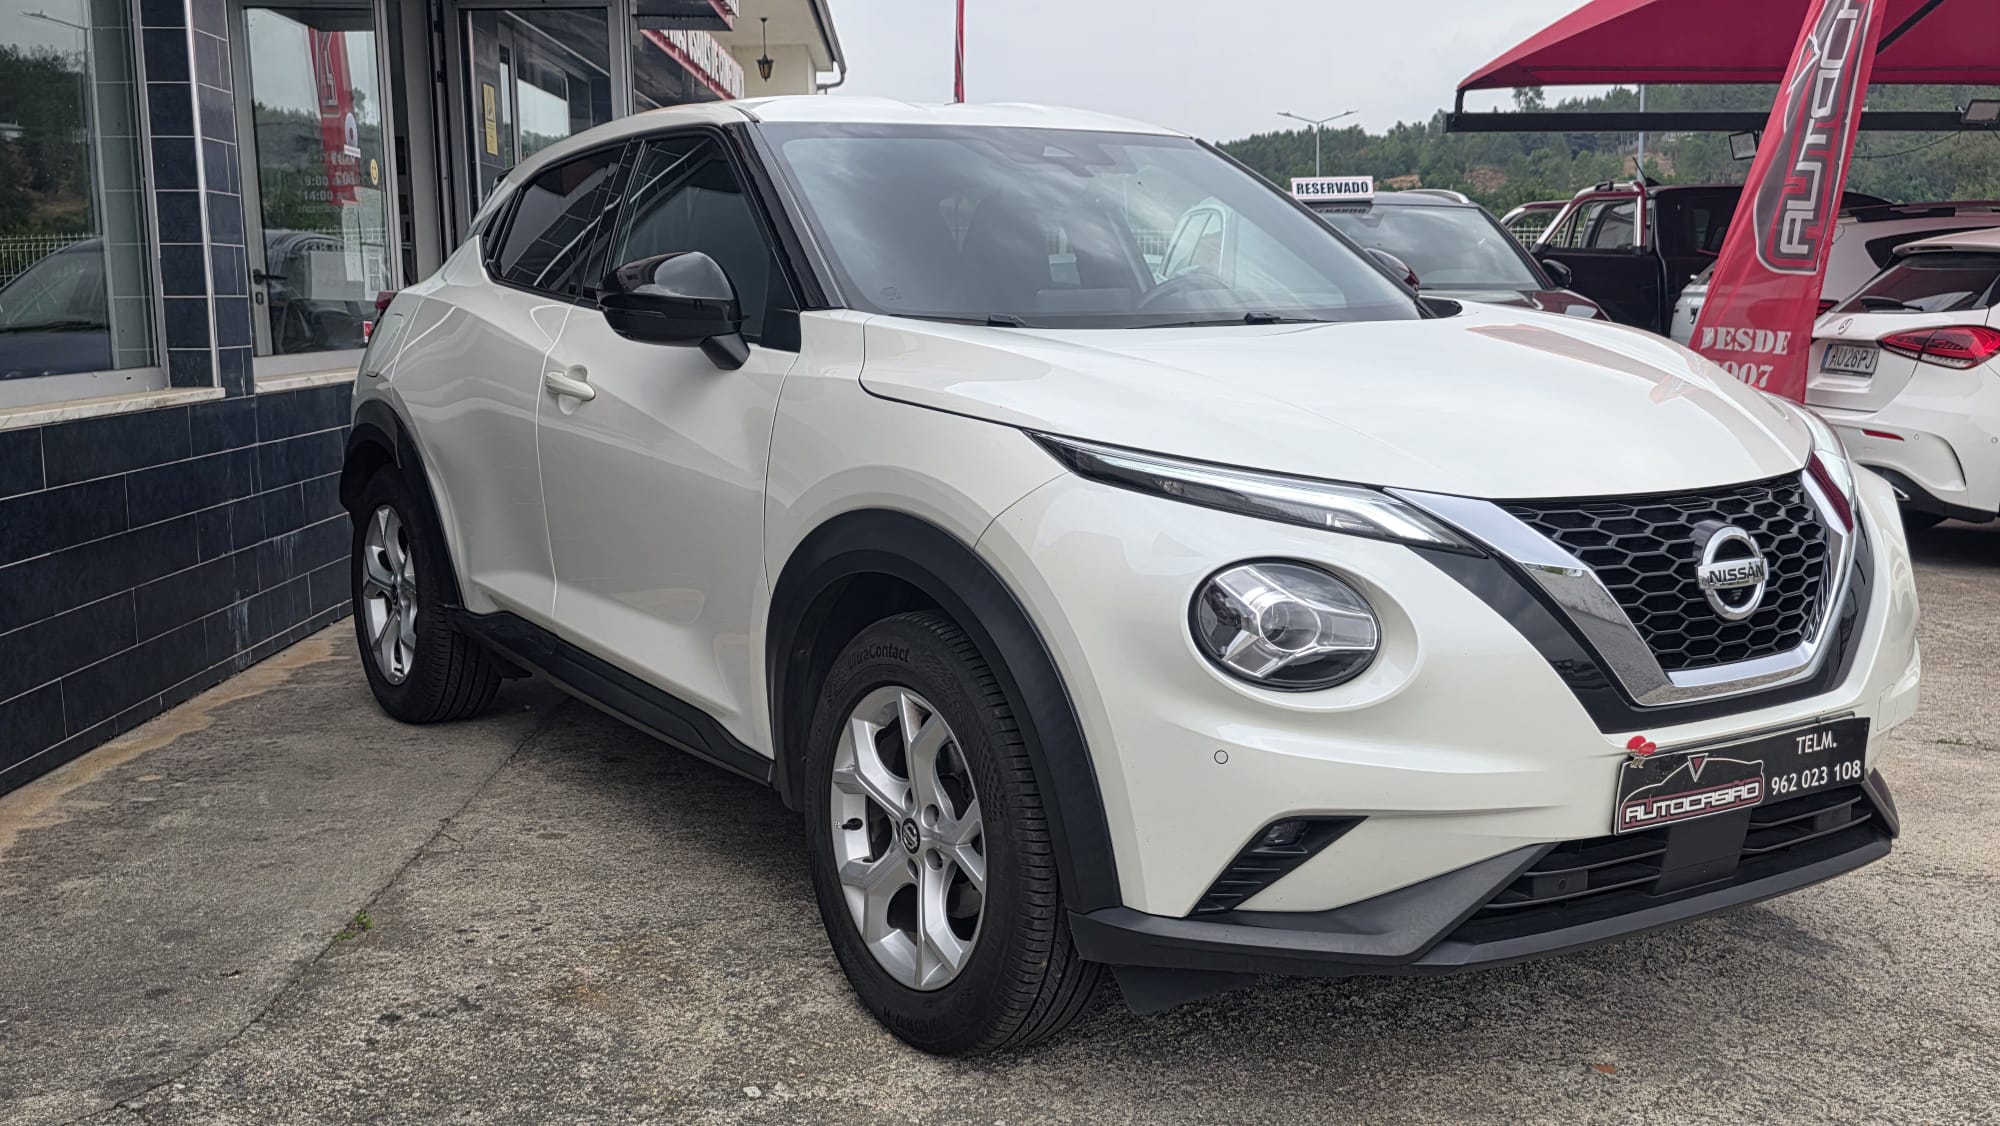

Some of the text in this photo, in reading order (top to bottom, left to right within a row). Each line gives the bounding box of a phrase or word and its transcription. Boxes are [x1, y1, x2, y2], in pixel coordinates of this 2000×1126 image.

[1295, 181, 1370, 195] RESERVADO
[1700, 327, 1792, 356] DESDE
[1711, 359, 1774, 389] 007
[1708, 561, 1765, 584] NISSAN
[1796, 730, 1837, 755] TELM.
[1771, 760, 1862, 796] 962 023 108
